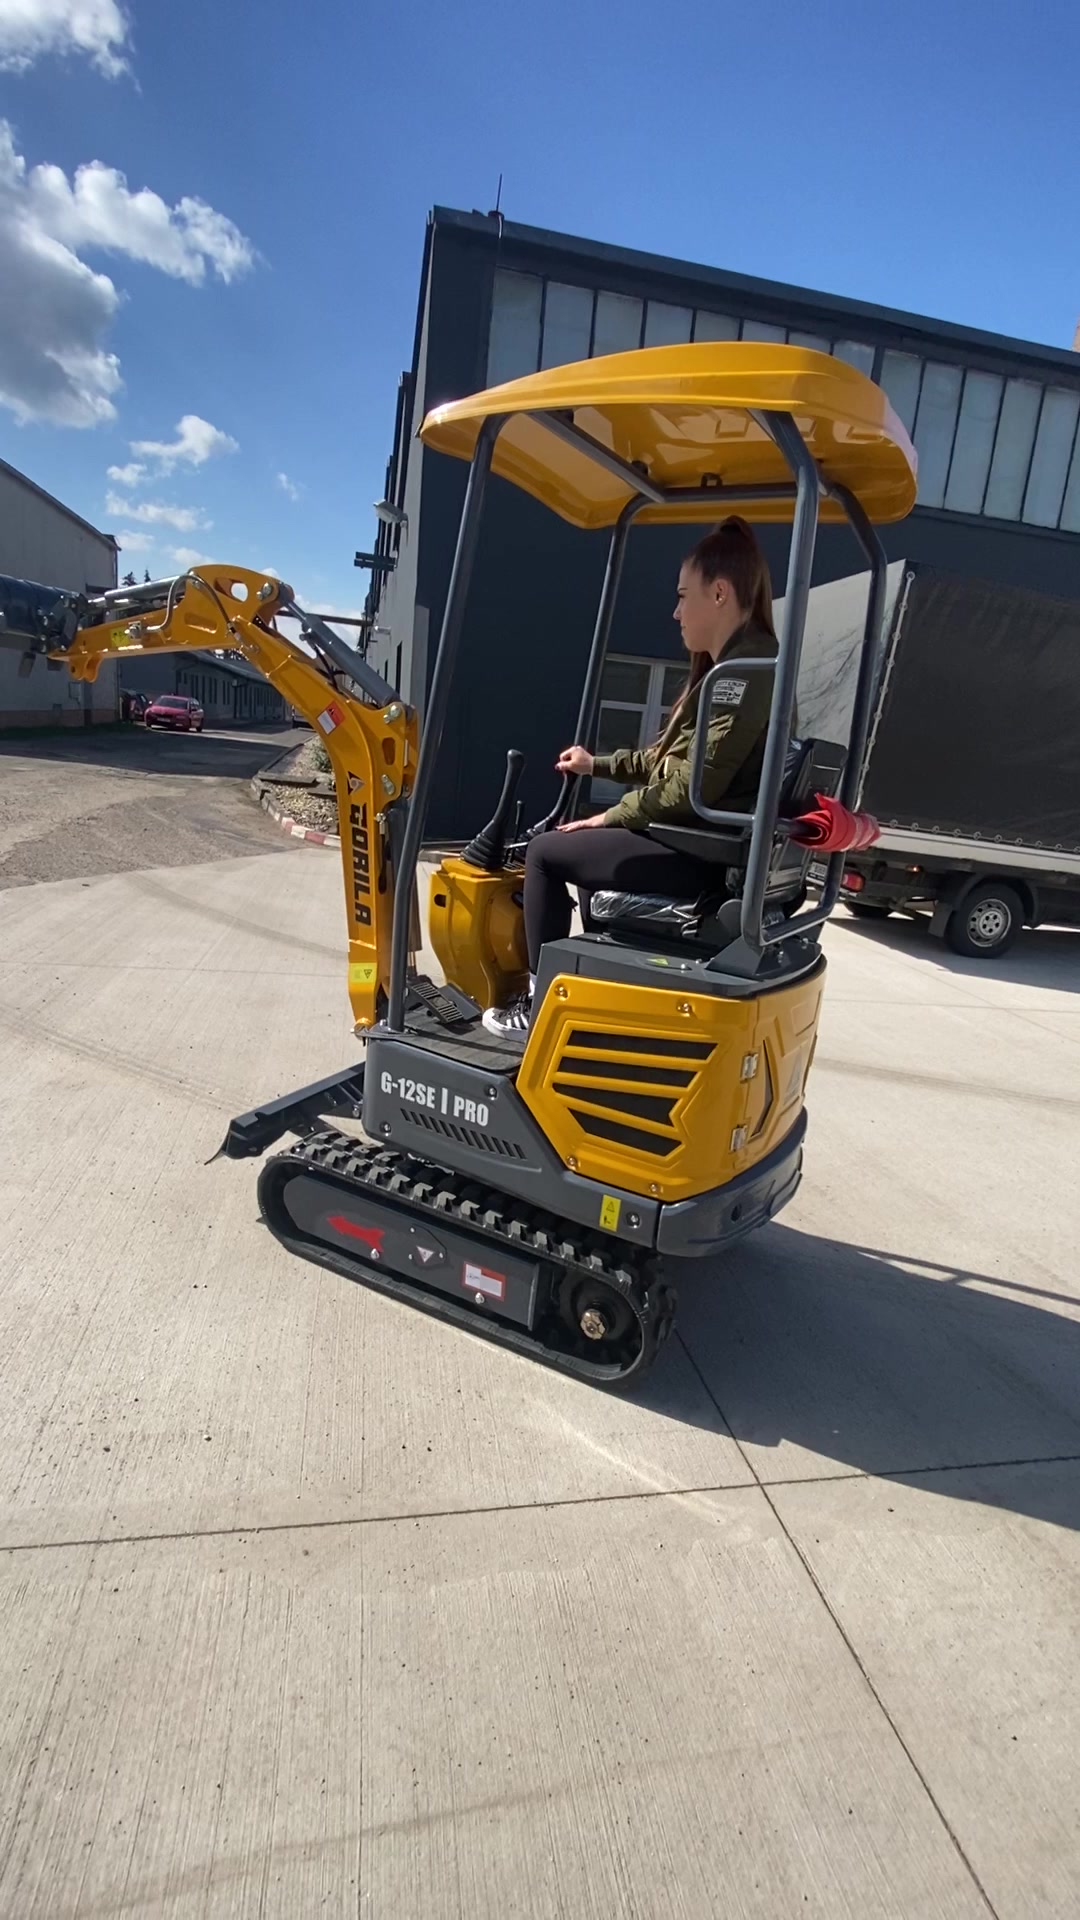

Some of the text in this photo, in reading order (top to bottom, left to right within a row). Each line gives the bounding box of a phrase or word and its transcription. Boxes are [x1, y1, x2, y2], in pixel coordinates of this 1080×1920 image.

[350, 802, 372, 926] GORILA
[380, 1071, 436, 1109] G-12SE
[453, 1095, 489, 1127] PRO
